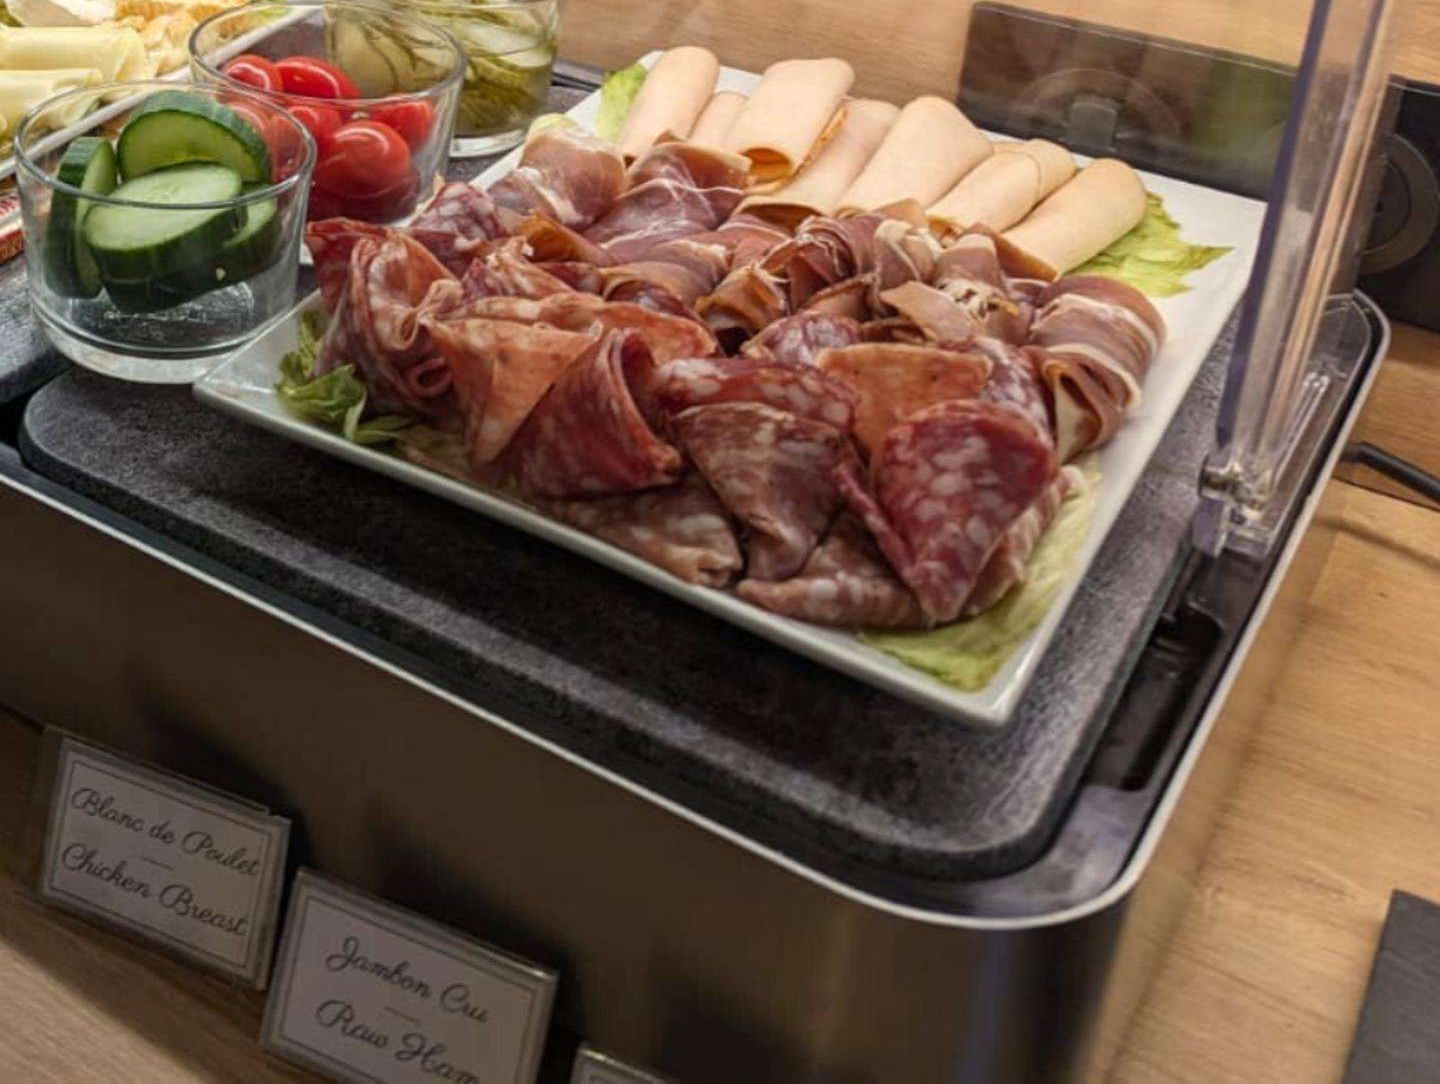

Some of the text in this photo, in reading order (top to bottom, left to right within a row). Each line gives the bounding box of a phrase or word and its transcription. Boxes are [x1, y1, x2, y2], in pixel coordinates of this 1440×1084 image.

[71, 788, 262, 877] Blanc de Poulet
[61, 842, 250, 936] Chicken Breast
[316, 999, 389, 1048] Raw
[324, 936, 489, 1023] Jambon Cru
